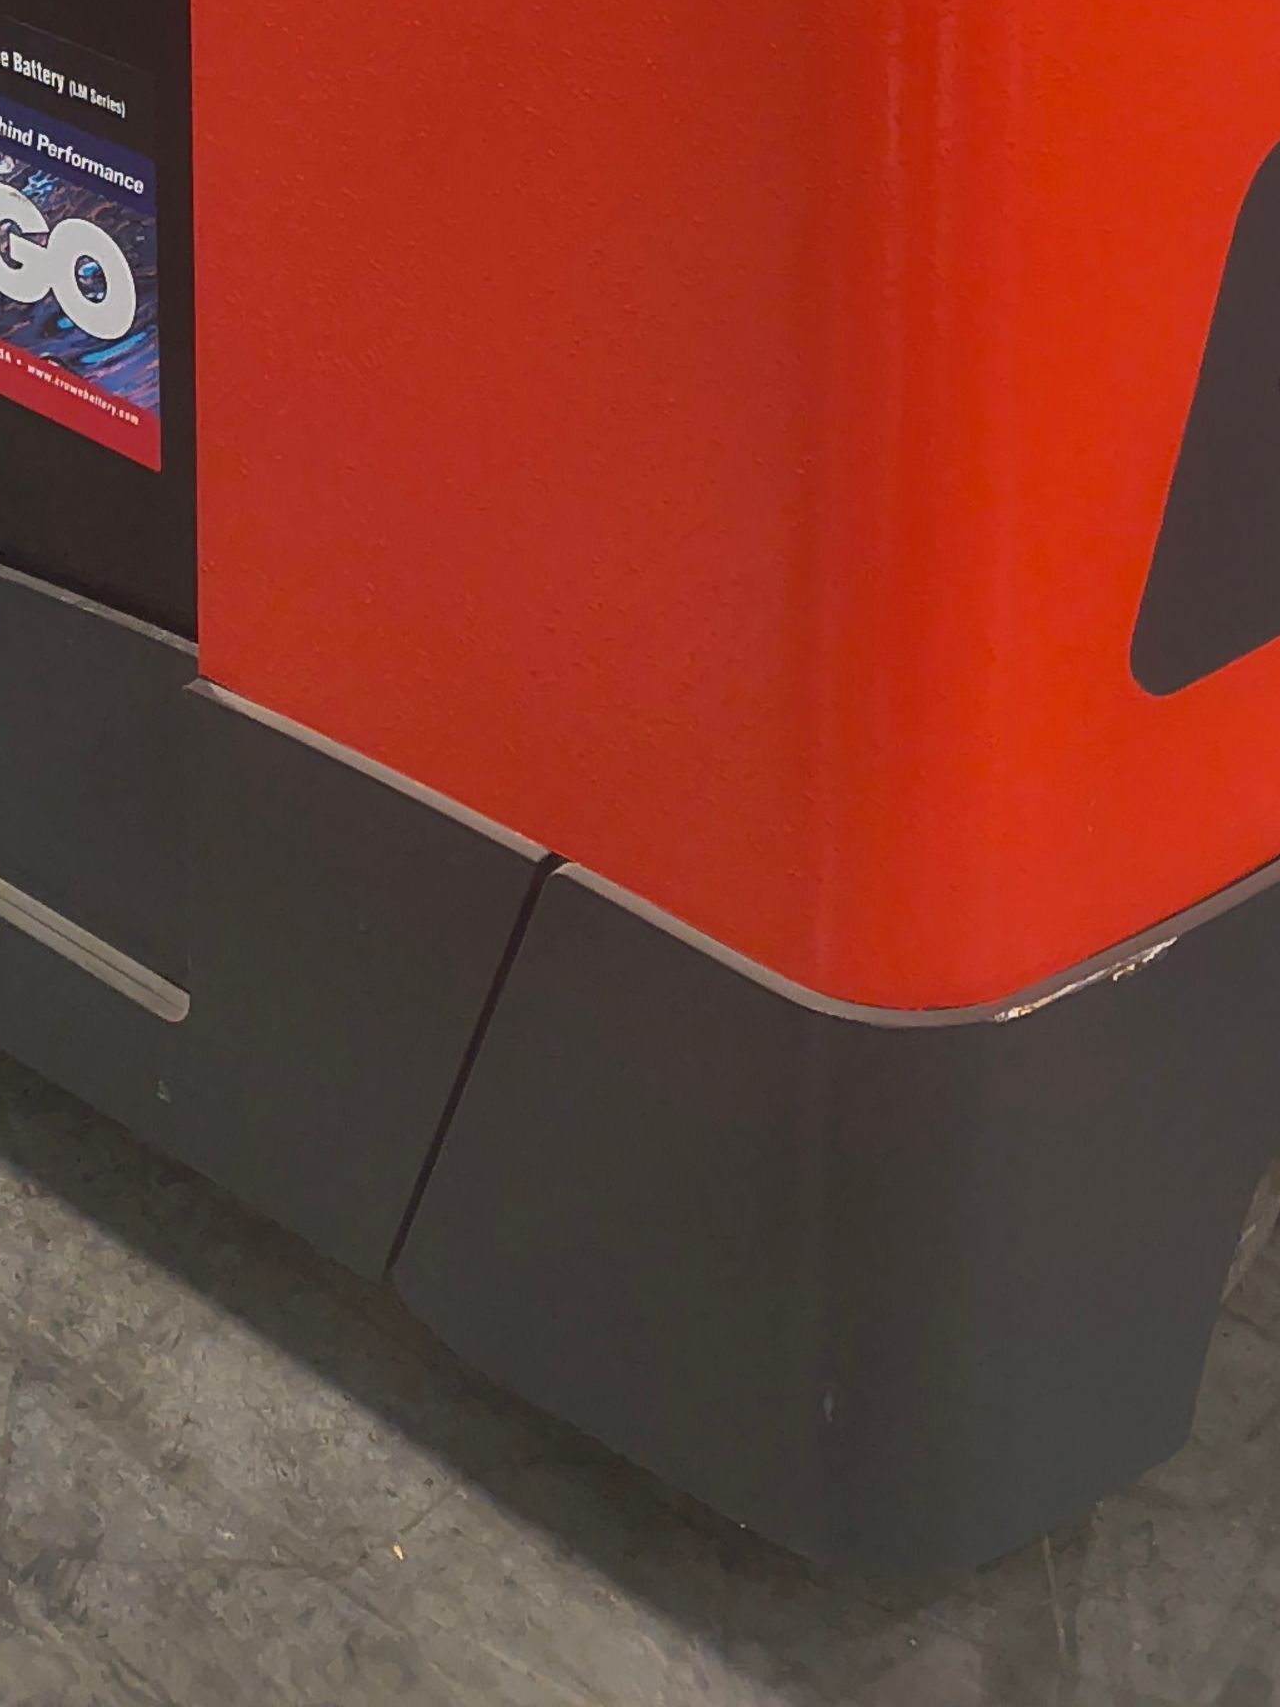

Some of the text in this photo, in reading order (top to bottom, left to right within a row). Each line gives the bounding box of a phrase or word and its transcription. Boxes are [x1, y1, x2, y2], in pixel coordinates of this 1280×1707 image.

[12, 51, 65, 94] Battery
[68, 79, 88, 101] (LM
[89, 88, 126, 118] Series)
[36, 133, 145, 194] Performance
